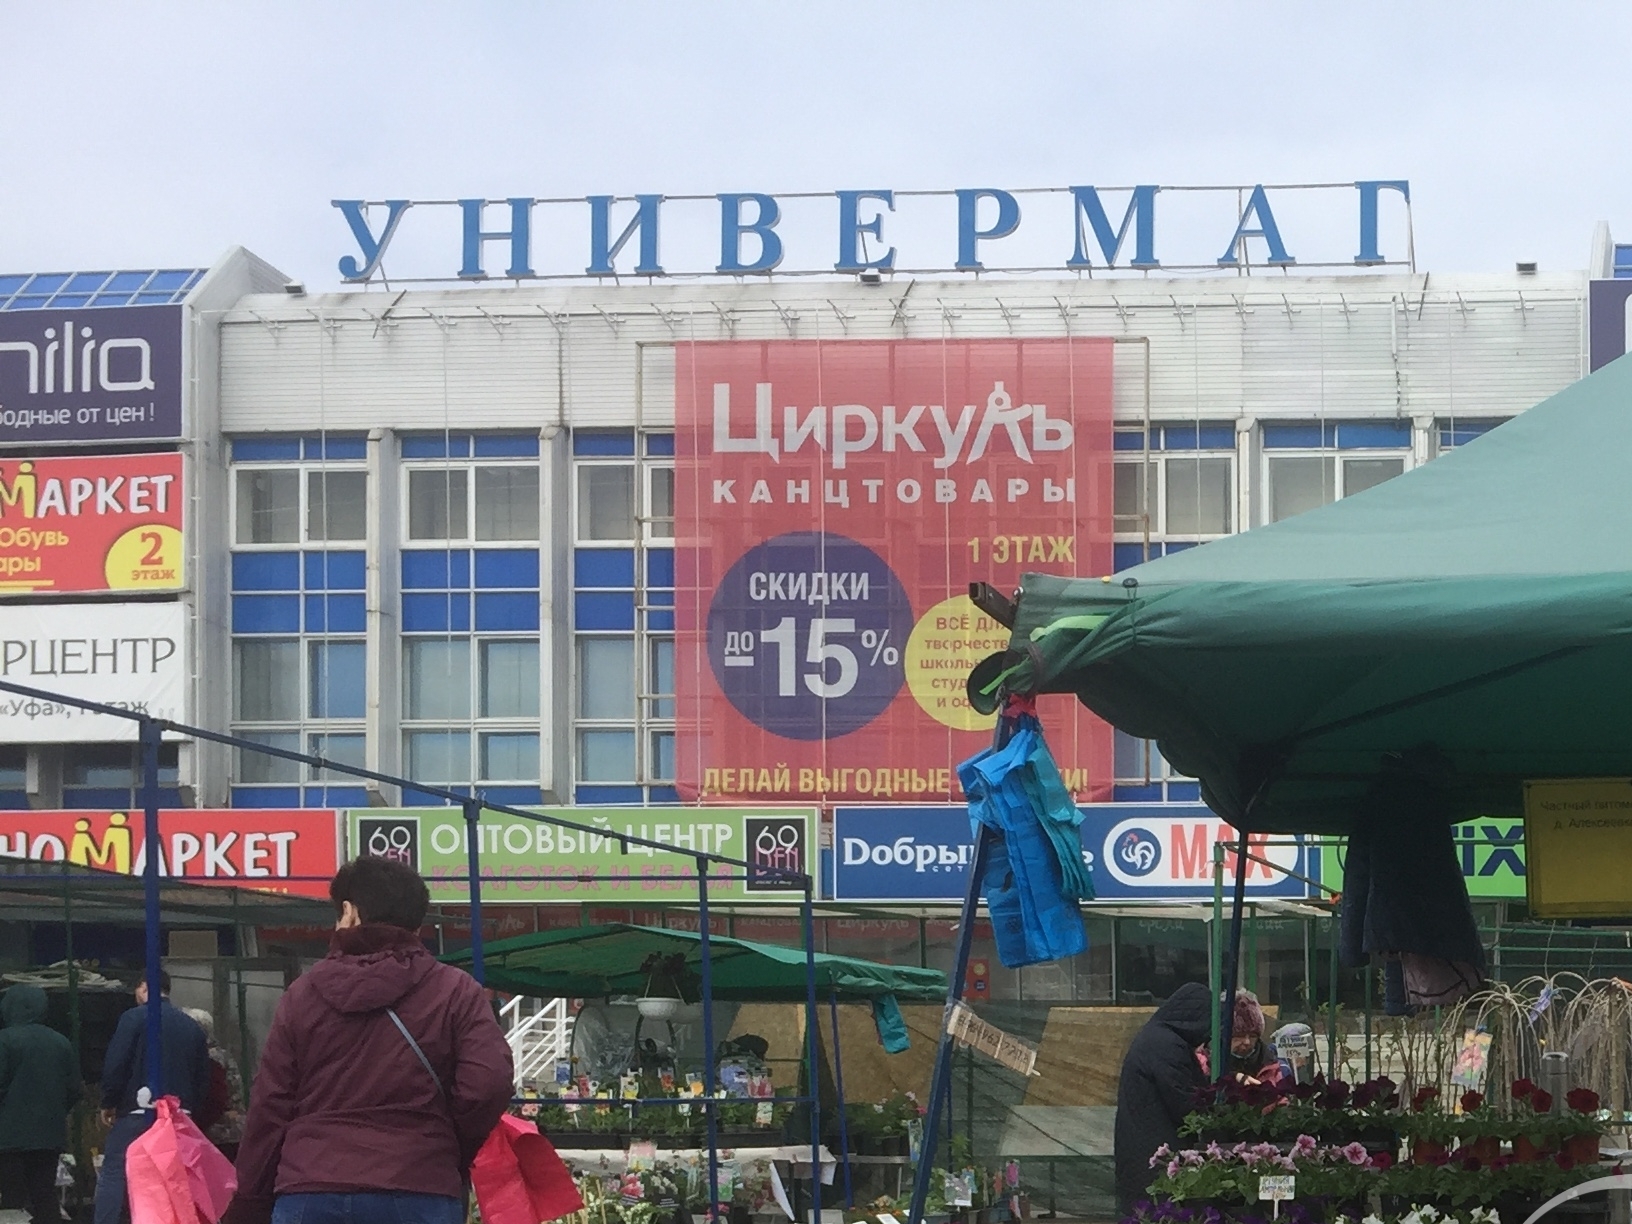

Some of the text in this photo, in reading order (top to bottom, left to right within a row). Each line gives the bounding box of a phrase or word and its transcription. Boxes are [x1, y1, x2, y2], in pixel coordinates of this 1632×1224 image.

[331, 179, 1410, 280] УНИВЕРМАГ
[77, 407, 100, 424] от
[106, 406, 145, 426] цен
[713, 381, 1074, 468] Циркуль
[713, 478, 1076, 508] КАНЦТОВАРЫ
[140, 531, 163, 566] 2
[967, 534, 1075, 564] 1 ЭТАЖ
[131, 569, 175, 581] этаж
[749, 572, 870, 605] СКИДКИ
[3, 637, 176, 678] РЦЕНТР
[724, 630, 755, 655] ДО
[702, 763, 791, 797] ДЕЛАЙ
[799, 768, 950, 797] ВЫГОДНЫЕ
[369, 826, 411, 856] 69
[626, 823, 733, 857] ЦЕНТР
[756, 825, 799, 855] 69
[611, 864, 630, 890] И
